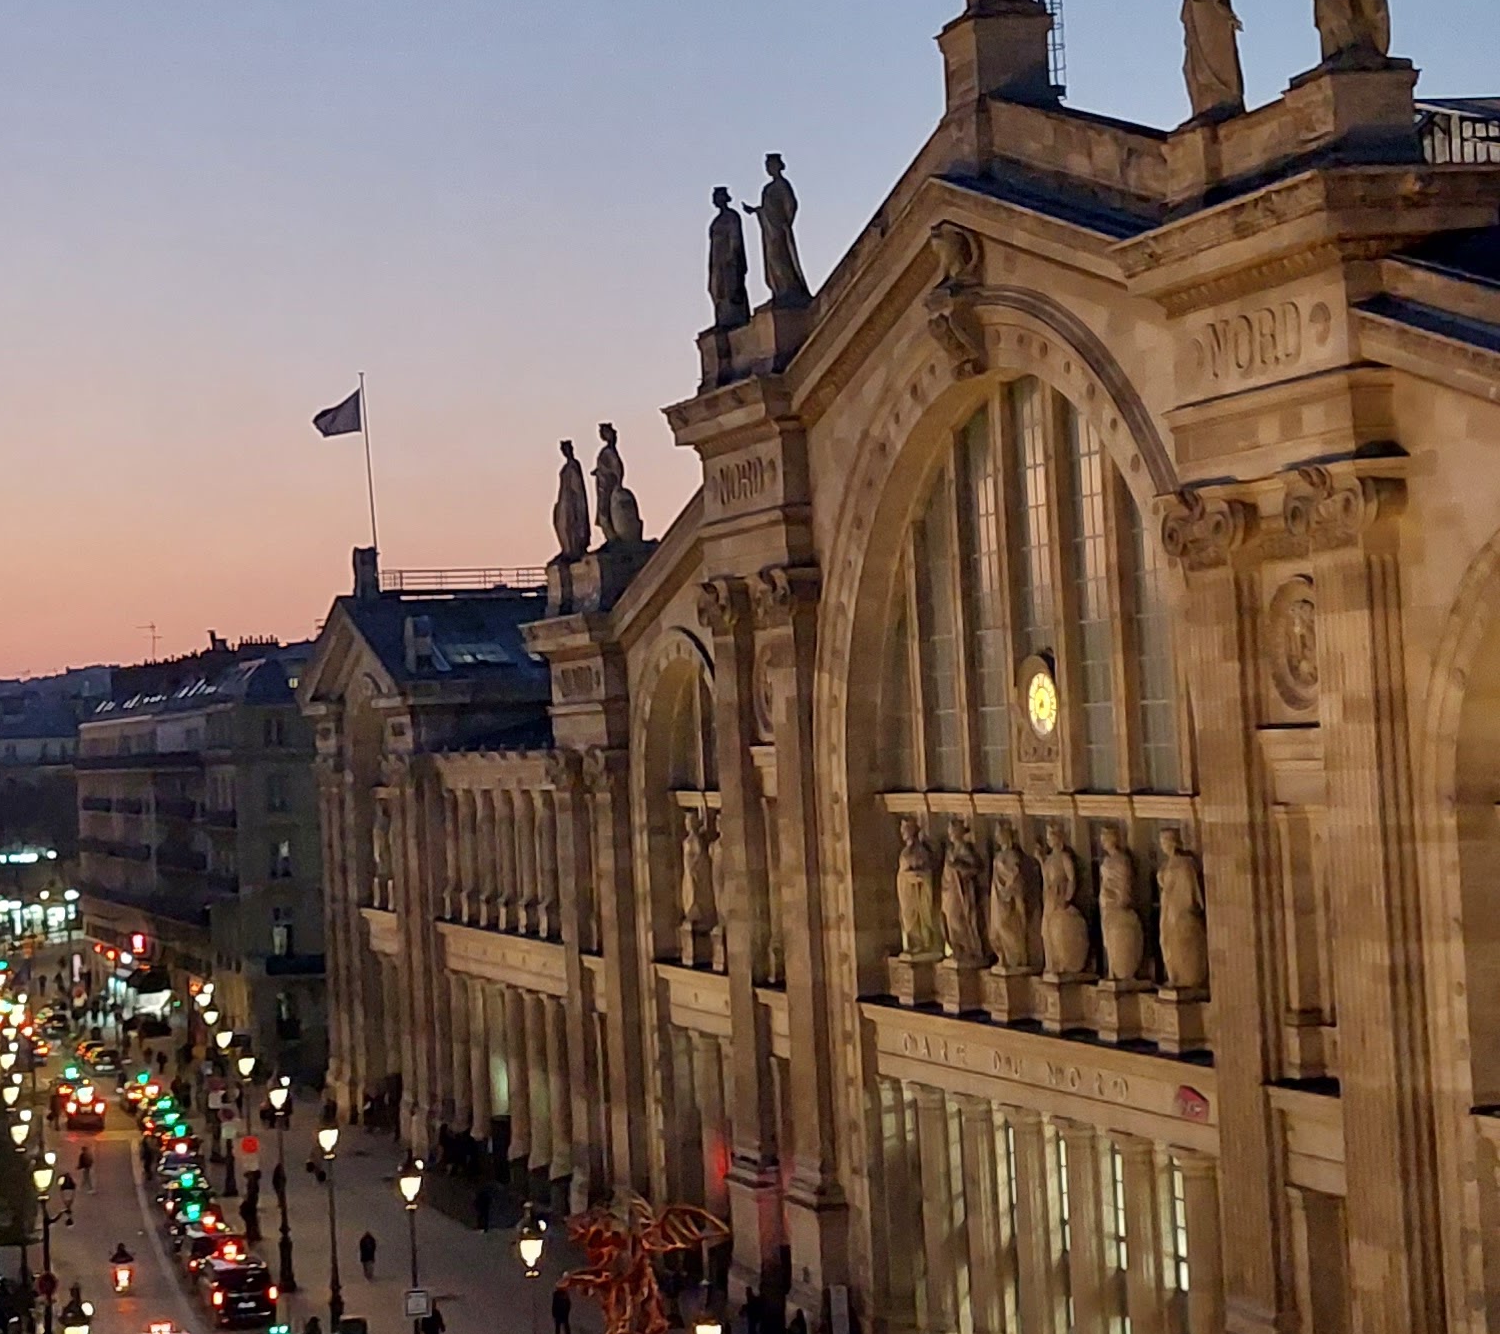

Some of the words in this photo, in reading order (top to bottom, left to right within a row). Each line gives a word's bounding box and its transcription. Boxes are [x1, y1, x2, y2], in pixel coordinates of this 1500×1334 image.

[1205, 300, 1300, 380] NORD
[902, 1032, 969, 1066] GARE
[992, 1050, 1025, 1077] DU
[1044, 1060, 1130, 1103] NORD
